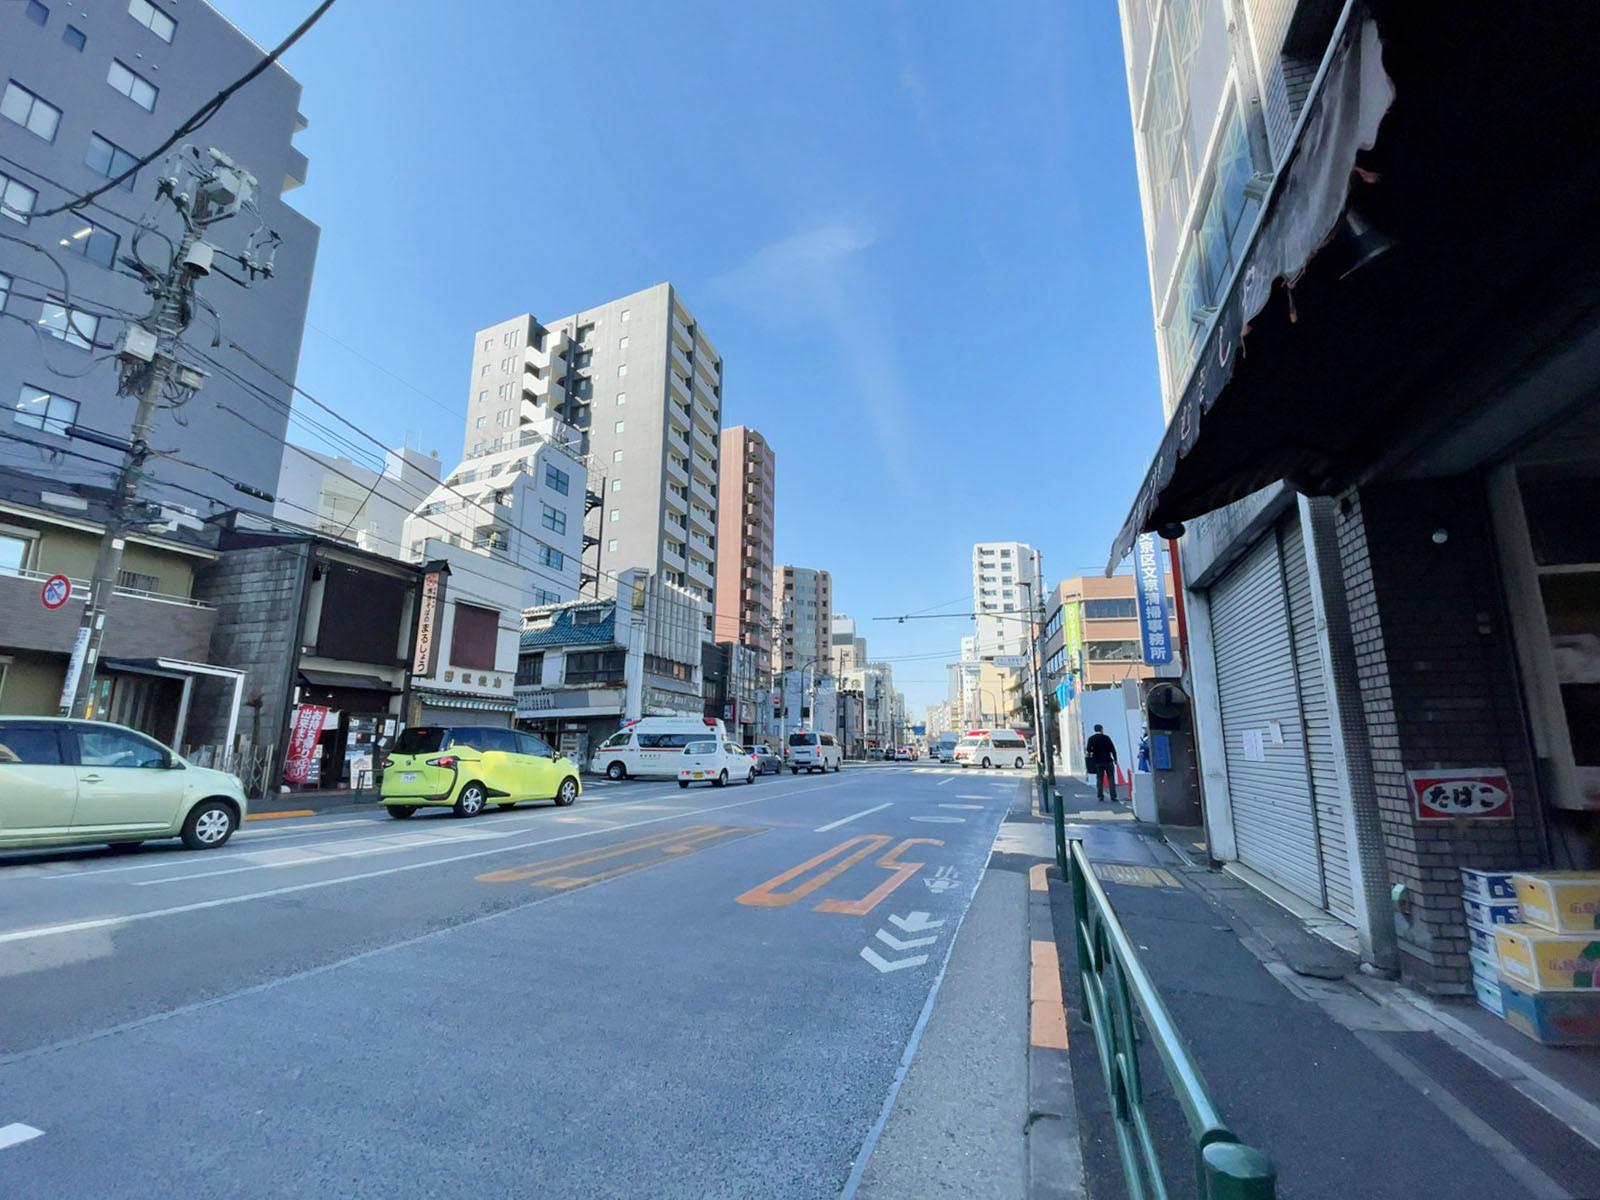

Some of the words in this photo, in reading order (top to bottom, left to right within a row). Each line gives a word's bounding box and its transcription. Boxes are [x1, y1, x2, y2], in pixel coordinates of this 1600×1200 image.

[1139, 533, 1166, 660] 文京区文京清掃事務所
[301, 710, 323, 758] お持ち帰り
[286, 759, 307, 767] TAKE
[290, 766, 306, 777] OUT
[1429, 784, 1495, 808] たばこ
[735, 834, 945, 916] 50
